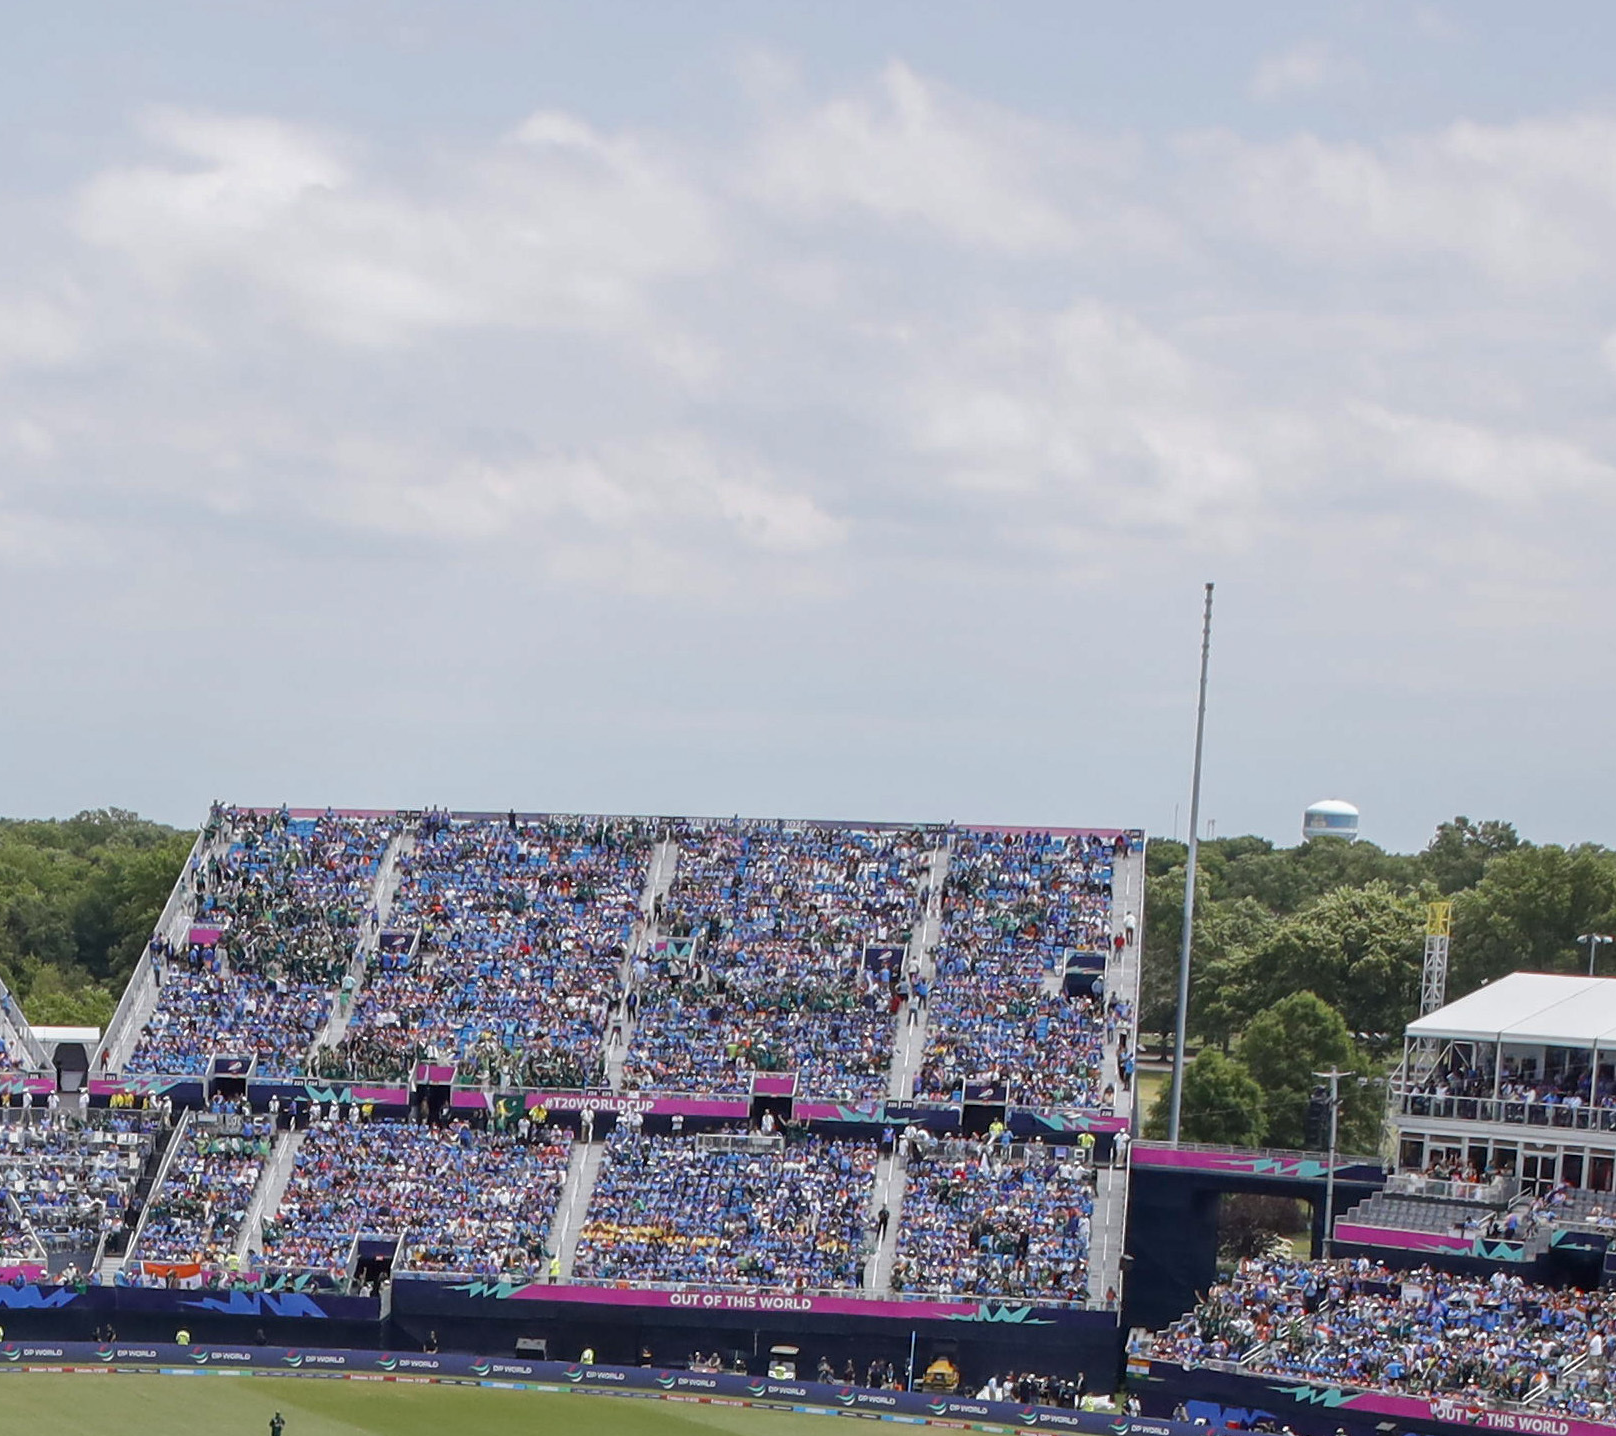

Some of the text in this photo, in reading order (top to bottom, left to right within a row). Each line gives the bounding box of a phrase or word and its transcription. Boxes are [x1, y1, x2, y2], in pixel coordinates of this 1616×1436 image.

[544, 1097, 654, 1111] #T20WORLDCUP
[670, 1293, 812, 1310] OUT OF THIS WORLD
[1486, 1412, 1517, 1429] THIS
[1518, 1416, 1569, 1435] WORLD
